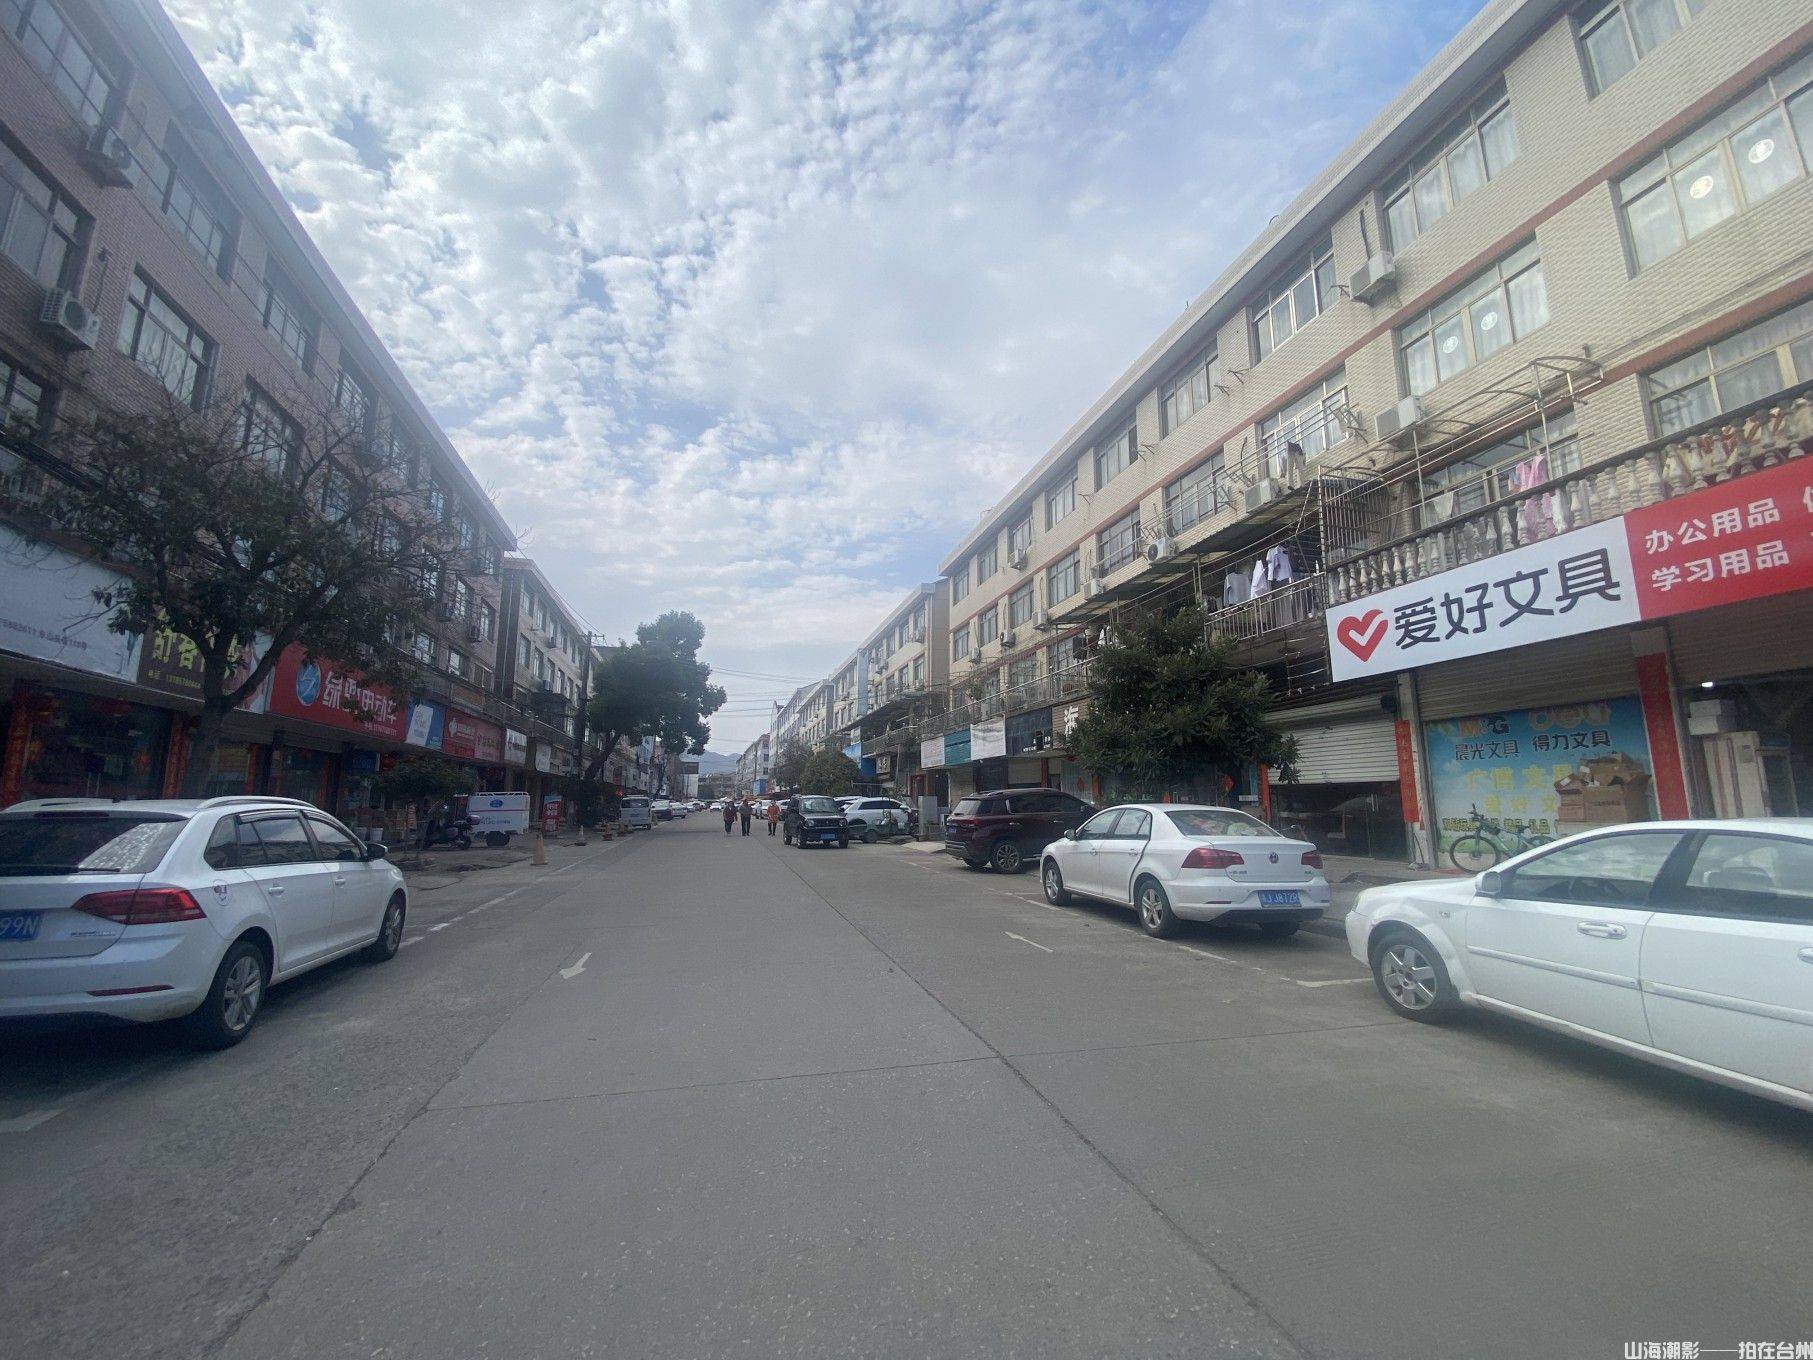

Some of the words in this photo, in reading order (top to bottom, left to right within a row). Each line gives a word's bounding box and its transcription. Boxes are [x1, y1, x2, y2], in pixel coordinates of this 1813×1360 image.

[1645, 497, 1780, 554] 办公用品
[1651, 540, 1790, 592] 学习用品
[1394, 547, 1621, 650] 爱好文具
[1455, 739, 1520, 761] 晨光文具
[1532, 729, 1611, 752] 得力文具
